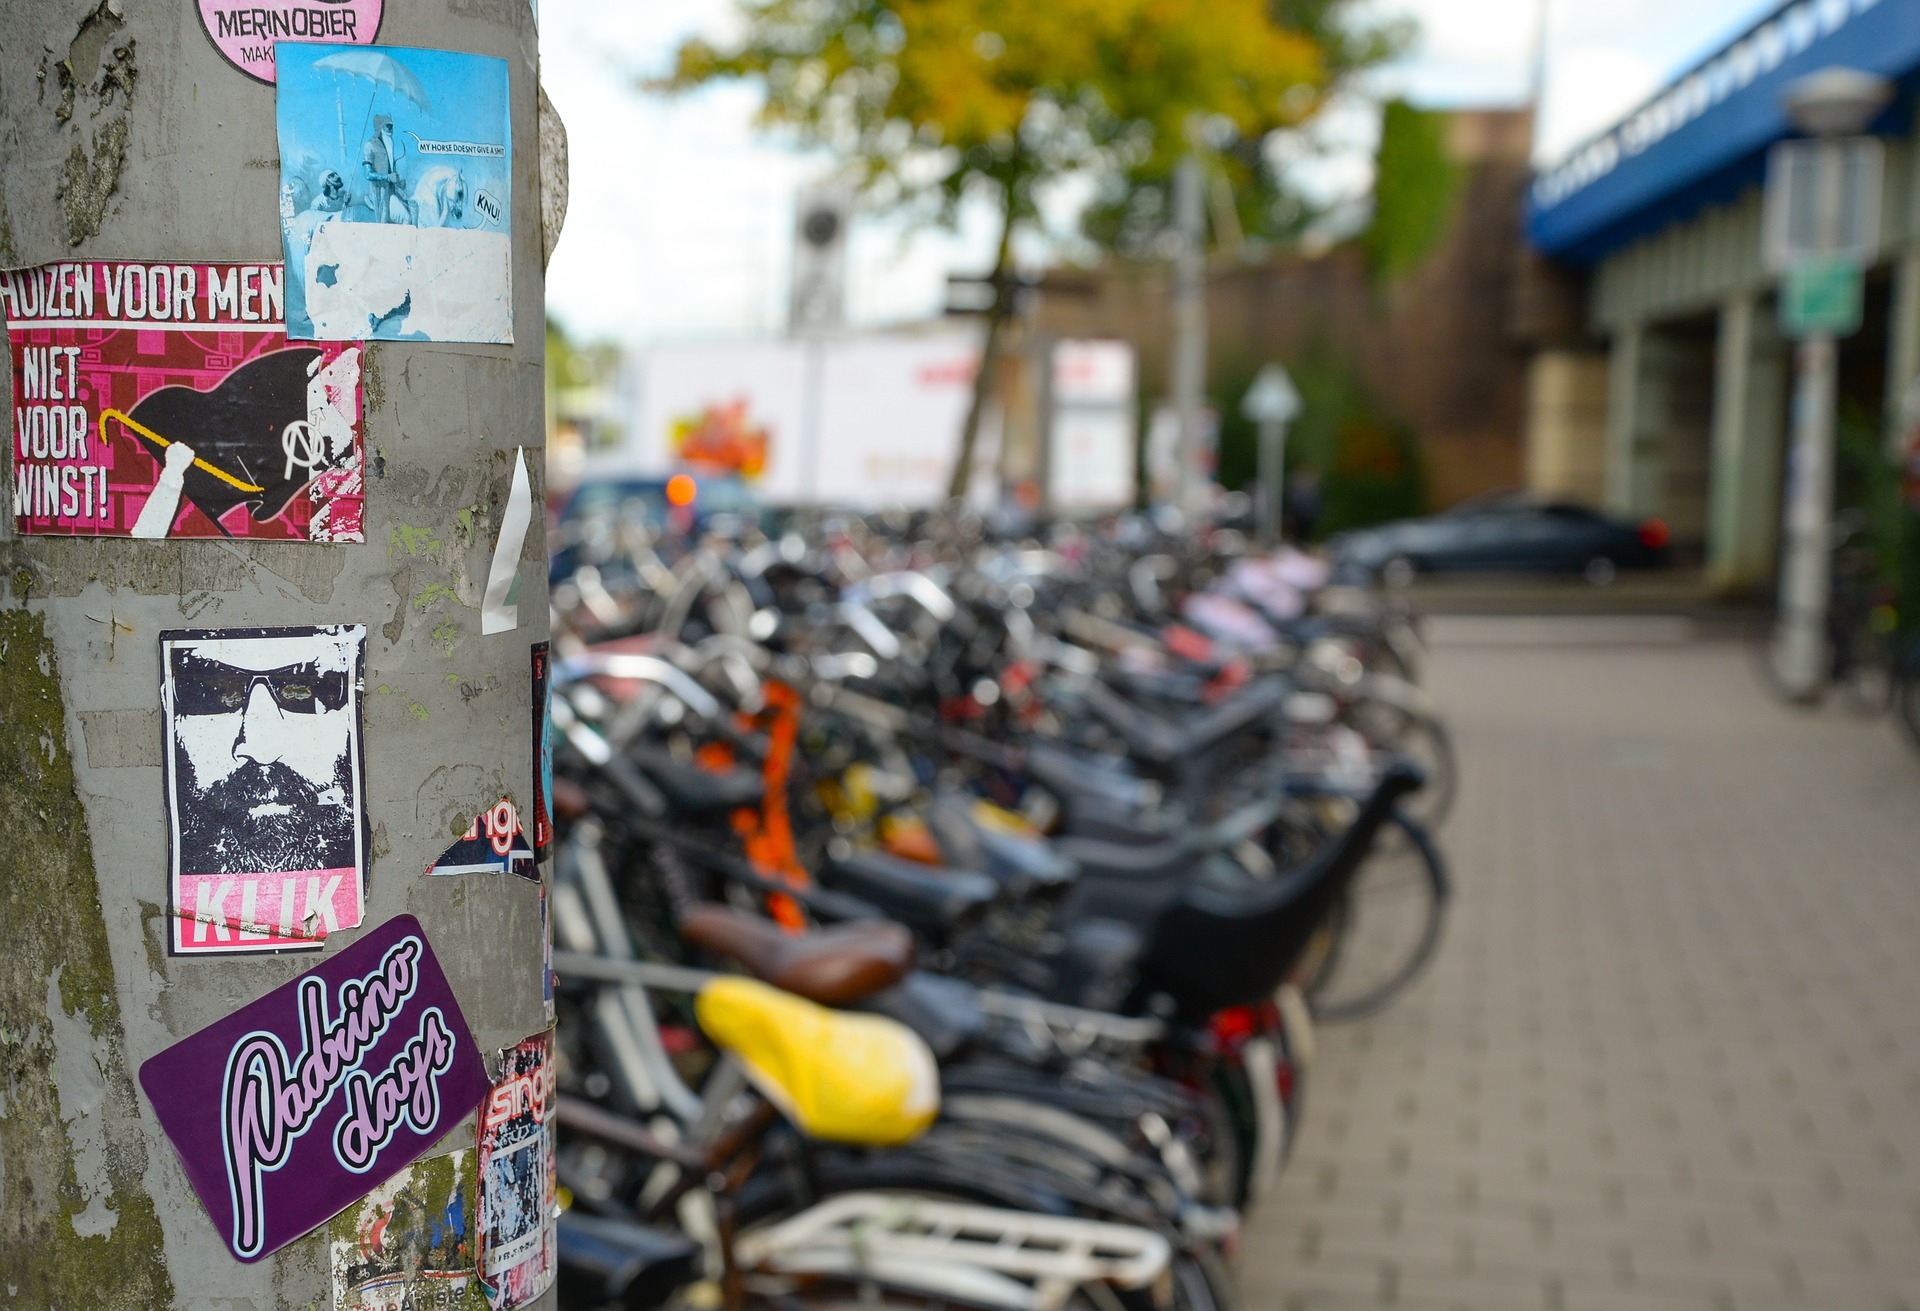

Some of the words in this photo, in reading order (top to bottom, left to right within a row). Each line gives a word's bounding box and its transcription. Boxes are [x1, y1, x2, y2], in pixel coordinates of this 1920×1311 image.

[214, 8, 357, 41] MERINOBIER
[420, 143, 430, 151] MY
[431, 144, 453, 153] HORSE
[477, 146, 489, 155] GIVE
[477, 194, 501, 221] KNU!
[0, 263, 94, 318] HUIZEN
[103, 265, 197, 320] VOOR
[208, 266, 284, 321] MEN
[23, 346, 81, 400] NIET
[17, 405, 88, 460] VOOR
[15, 464, 108, 519] WINST!
[193, 875, 343, 943] KLIK
[337, 1011, 453, 1169] days
[487, 1045, 556, 1122] single
